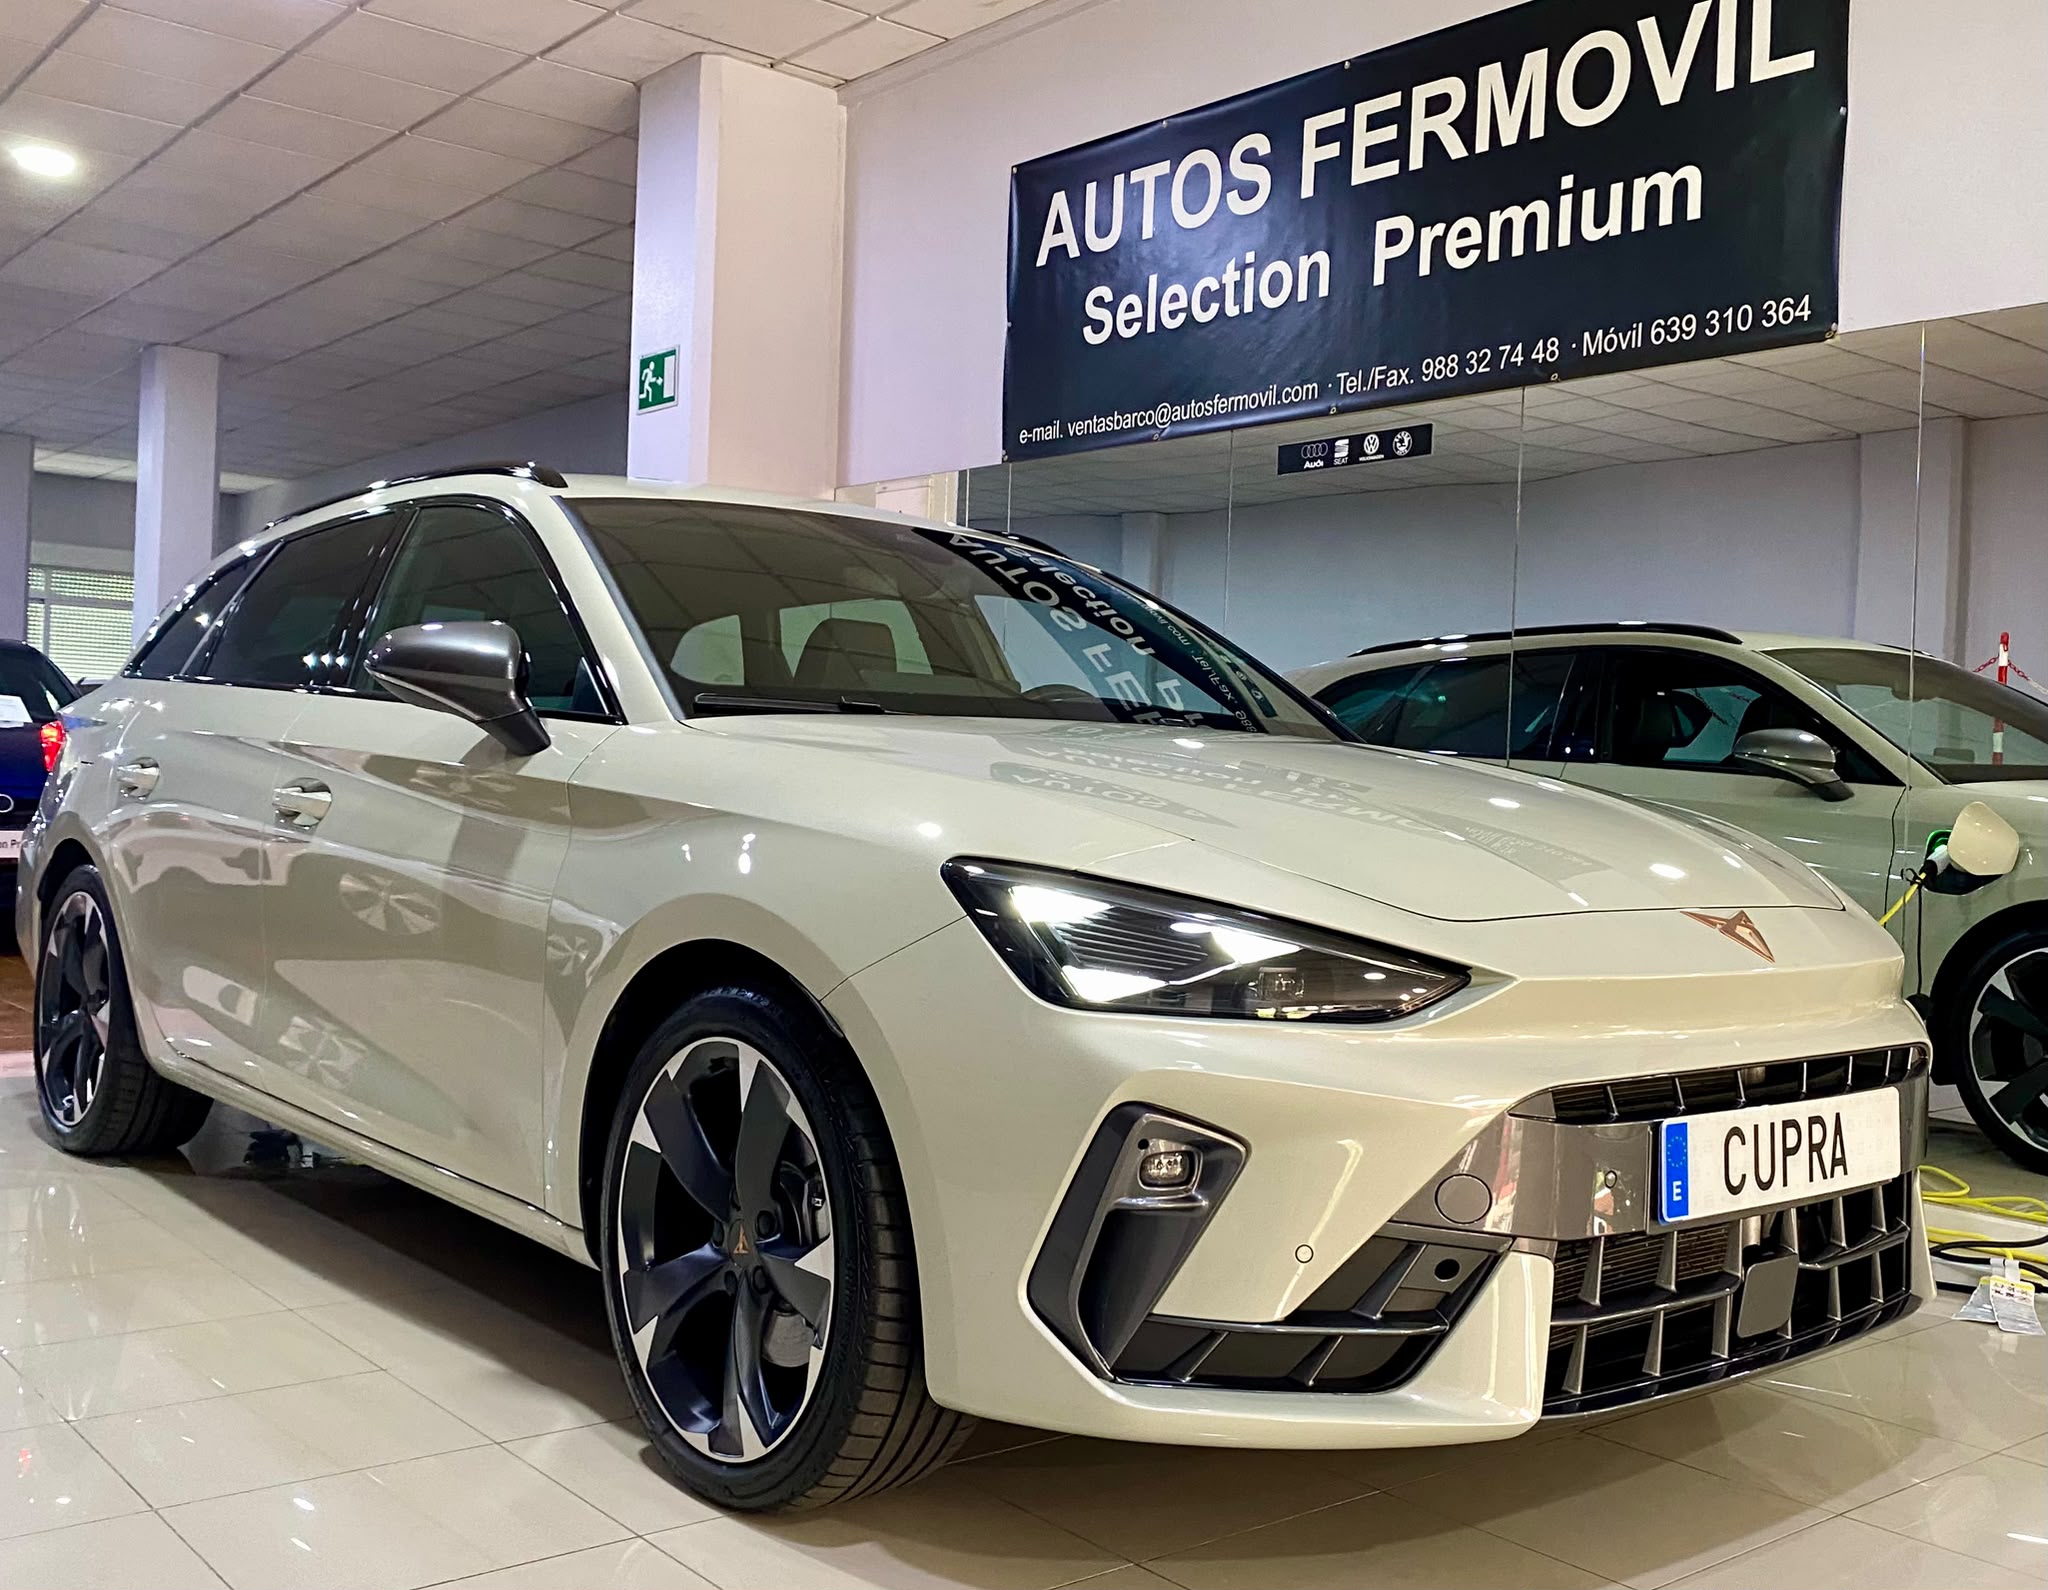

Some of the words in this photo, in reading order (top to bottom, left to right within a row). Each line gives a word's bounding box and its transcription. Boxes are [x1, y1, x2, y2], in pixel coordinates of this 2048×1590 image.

[1035, 133, 1273, 267] AUTOS
[1299, 0, 1816, 200] FERMOVIL
[1082, 246, 1331, 346] Selection
[1373, 165, 1703, 287] Premium
[1019, 419, 1063, 444] e-mail.
[1067, 382, 1319, 437] ventasbarco@autosfermovil.com
[1336, 365, 1415, 396] Tel./Fax.
[1421, 353, 1459, 383] 988
[1465, 348, 1492, 375] 32
[1498, 342, 1524, 371] 74
[1531, 336, 1560, 365] 48
[1582, 322, 1643, 357] Móvil
[1650, 313, 1697, 346] 639
[1704, 304, 1753, 337] 310
[1761, 294, 1812, 328] 364
[1303, 459, 1324, 469] Audi
[1333, 457, 1349, 466] SEAT
[1672, 1180, 1682, 1202] E
[1724, 1112, 1848, 1196] CUPRA
